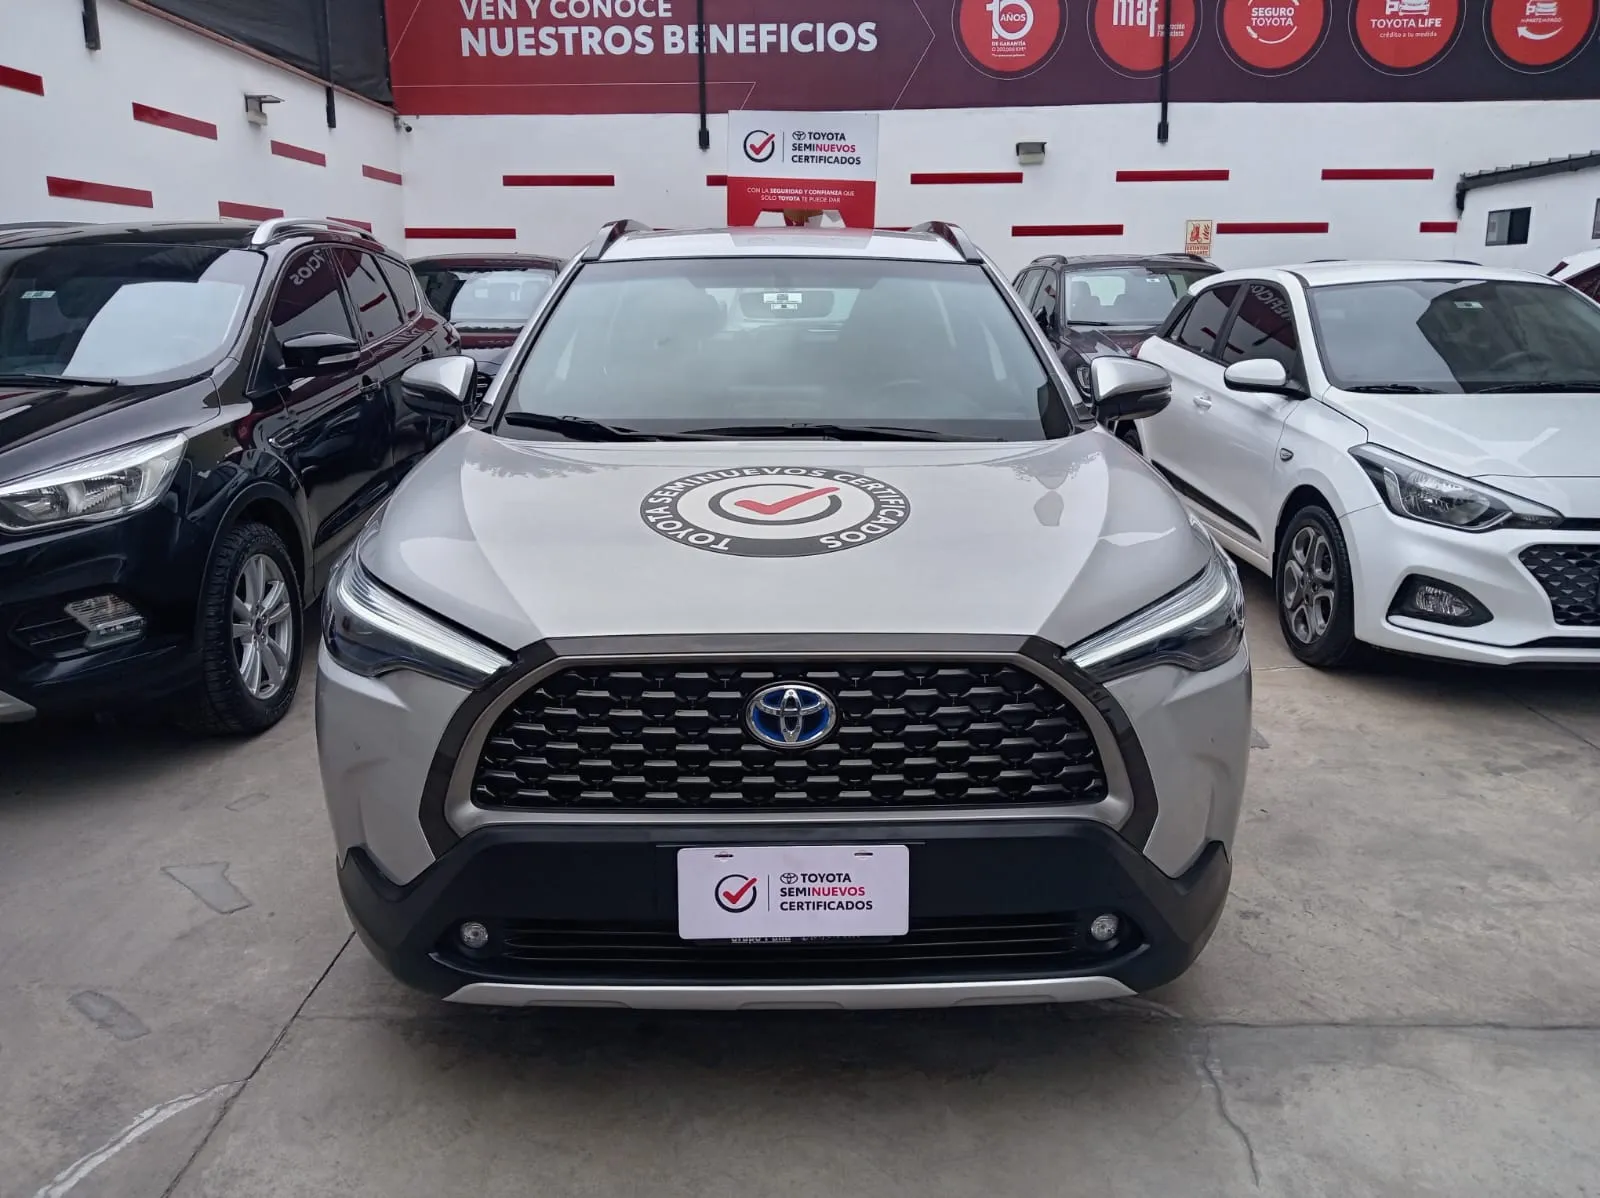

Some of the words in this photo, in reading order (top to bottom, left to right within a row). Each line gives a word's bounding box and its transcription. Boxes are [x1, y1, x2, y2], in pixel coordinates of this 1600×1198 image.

[461, 0, 518, 20] VEN
[526, 0, 541, 19] Y
[550, 0, 672, 19] CONOCE
[1251, 7, 1295, 17] SEGURO
[1000, 12, 1026, 22] AÑOS
[1251, 17, 1294, 26] TOYOTA
[1370, 18, 1417, 28] TOYOTA
[1418, 18, 1442, 28] LIFE
[460, 25, 655, 57] NUESTROS
[663, 22, 878, 54] BENEFICIOS
[808, 131, 846, 141] TOYOTA
[791, 142, 856, 153] SEMINUEVOS
[791, 154, 861, 165] CERTIFICADOS
[770, 187, 803, 195] SEGURIDAD
[649, 467, 827, 505] SEMINUEVOS
[819, 473, 905, 549] CERTIFICADOS
[645, 506, 729, 551] TOYOTA
[800, 873, 852, 883] TOYOTA
[780, 887, 866, 897] SEMINUEVOS
[780, 900, 873, 911] CERTIFICADOS
